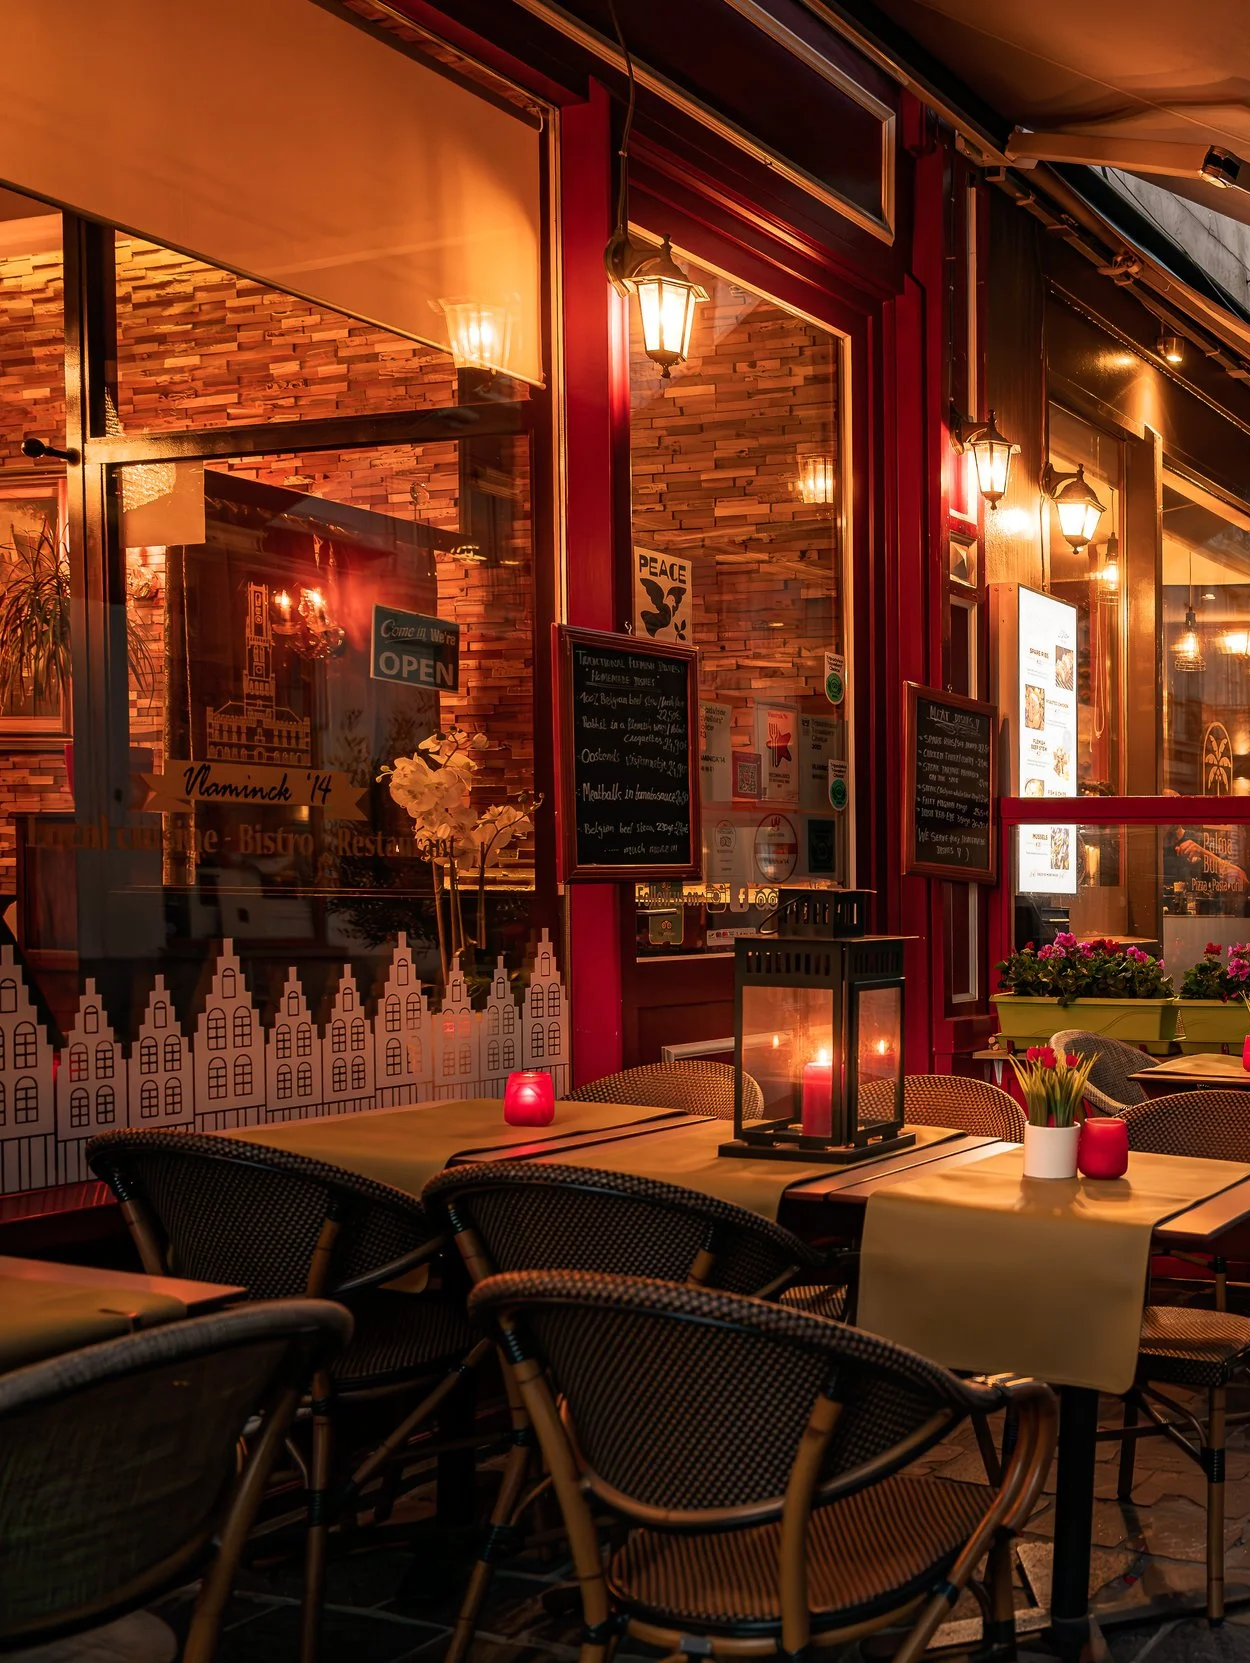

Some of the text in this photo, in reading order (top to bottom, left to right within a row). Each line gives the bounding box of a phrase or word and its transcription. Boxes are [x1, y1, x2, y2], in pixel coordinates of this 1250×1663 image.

[639, 553, 687, 585] PEACE
[381, 618, 456, 646] Come in We're
[378, 651, 454, 686] OPEN
[183, 762, 333, 805] Vlaminck '14
[582, 782, 623, 802] Meatballs
[624, 785, 635, 800] in
[239, 824, 314, 858] Bistro
[584, 821, 615, 840] Belgian
[1203, 831, 1233, 855] Palma
[1191, 877, 1208, 892] Pizza
